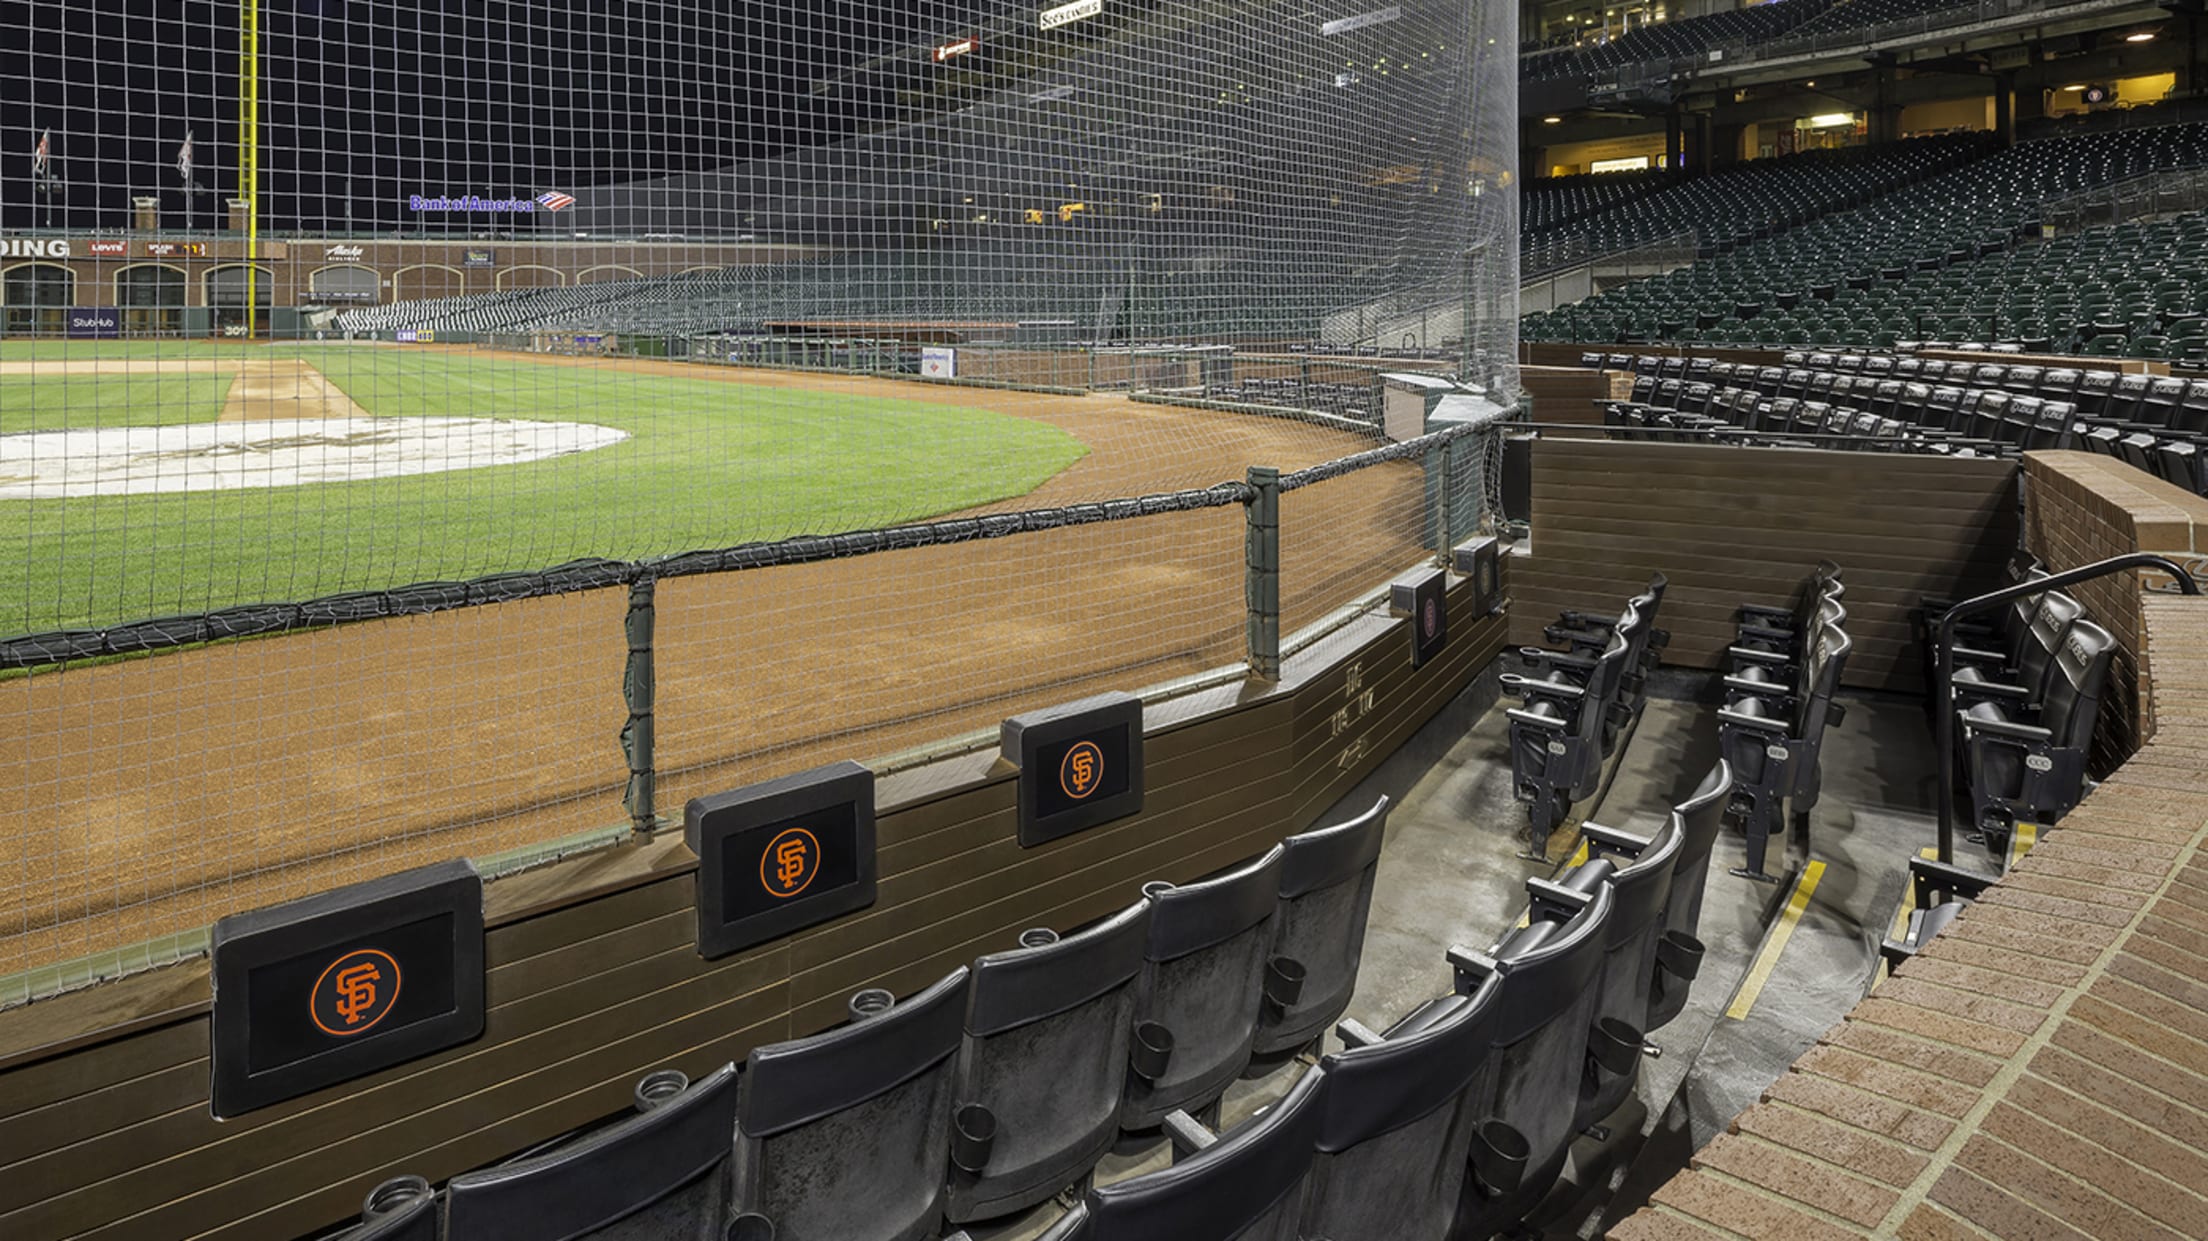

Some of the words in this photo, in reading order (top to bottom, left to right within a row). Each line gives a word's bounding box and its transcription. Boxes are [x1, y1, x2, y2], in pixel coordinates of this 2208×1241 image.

[410, 195, 449, 211] Bank
[451, 195, 469, 211] of
[470, 195, 534, 212] America
[325, 244, 364, 257] Alaska
[73, 318, 114, 328] StubHub
[1072, 750, 1095, 791] SF
[776, 837, 807, 888] SF
[336, 961, 381, 1025] SF
